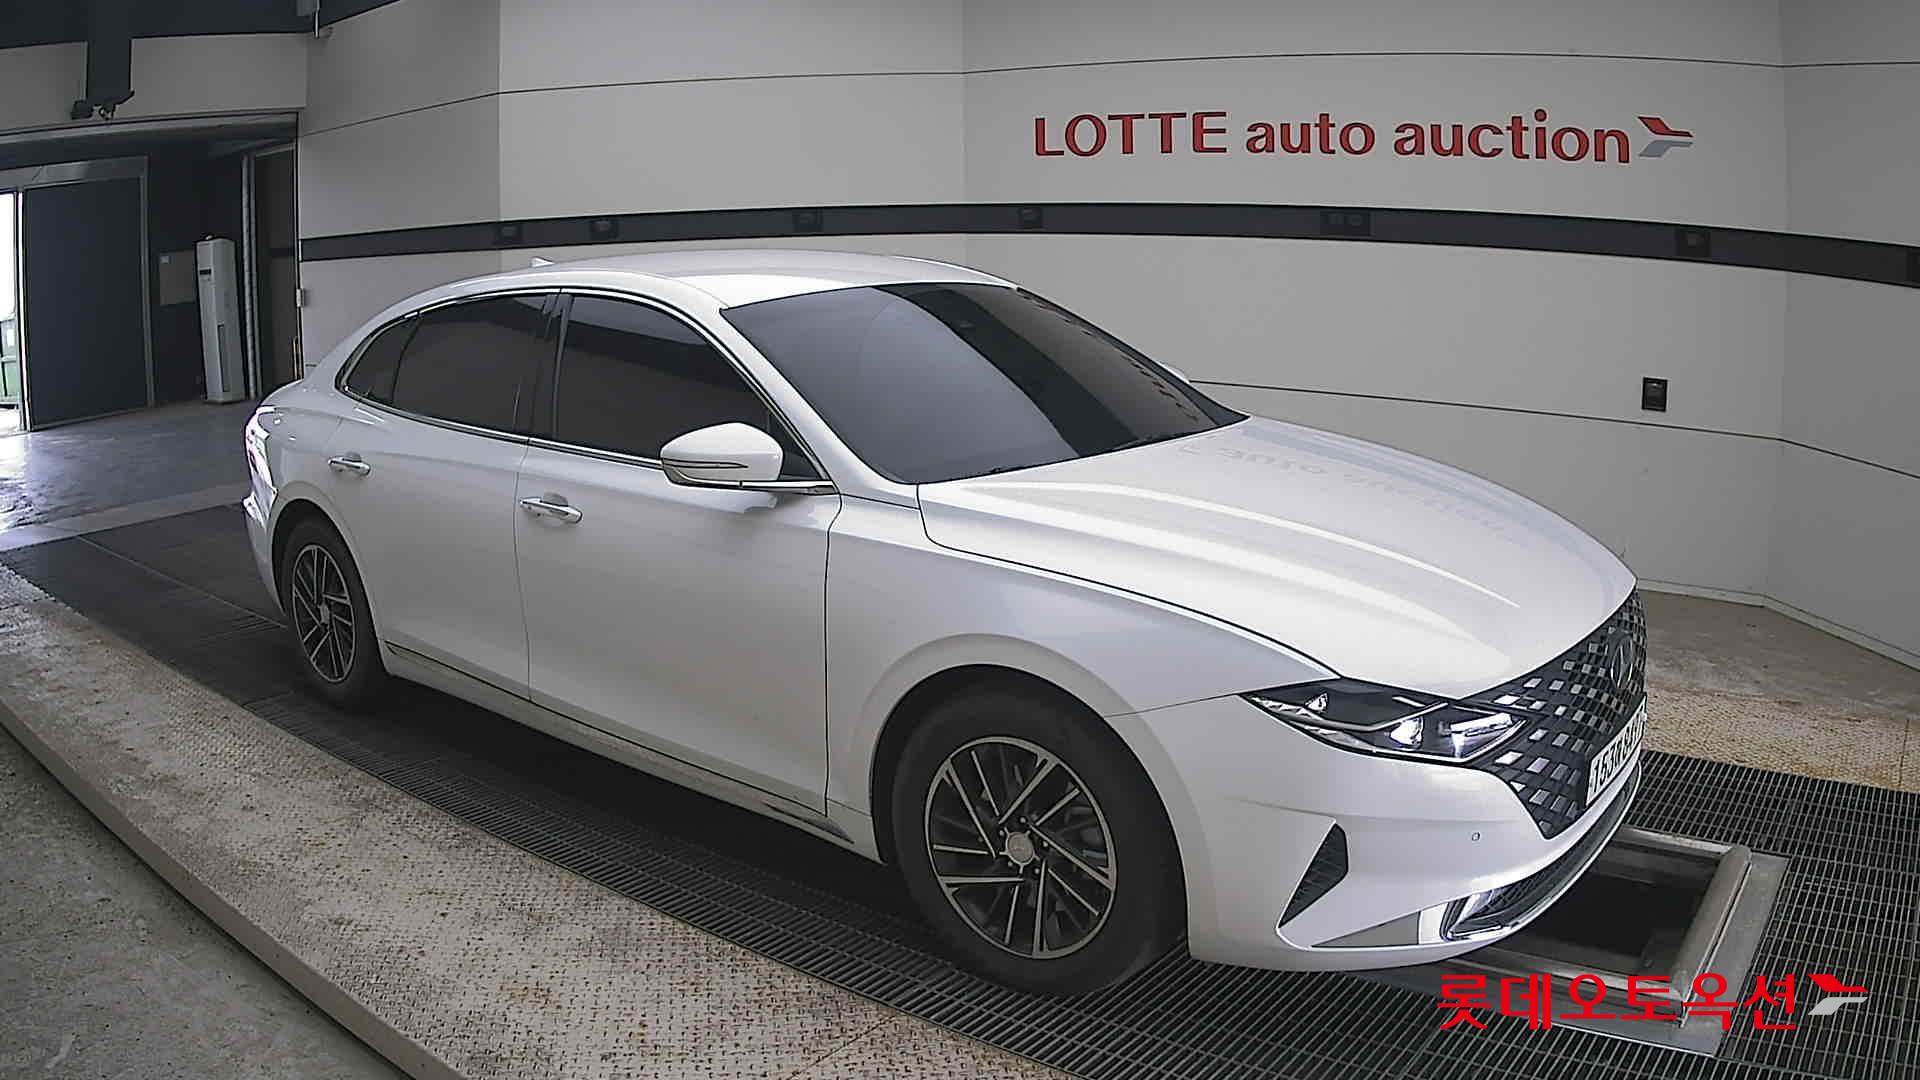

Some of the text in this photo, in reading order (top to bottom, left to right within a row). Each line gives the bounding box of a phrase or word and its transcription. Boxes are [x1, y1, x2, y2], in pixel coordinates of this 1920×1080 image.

[1035, 109, 1630, 163] LOTTE auto auction
